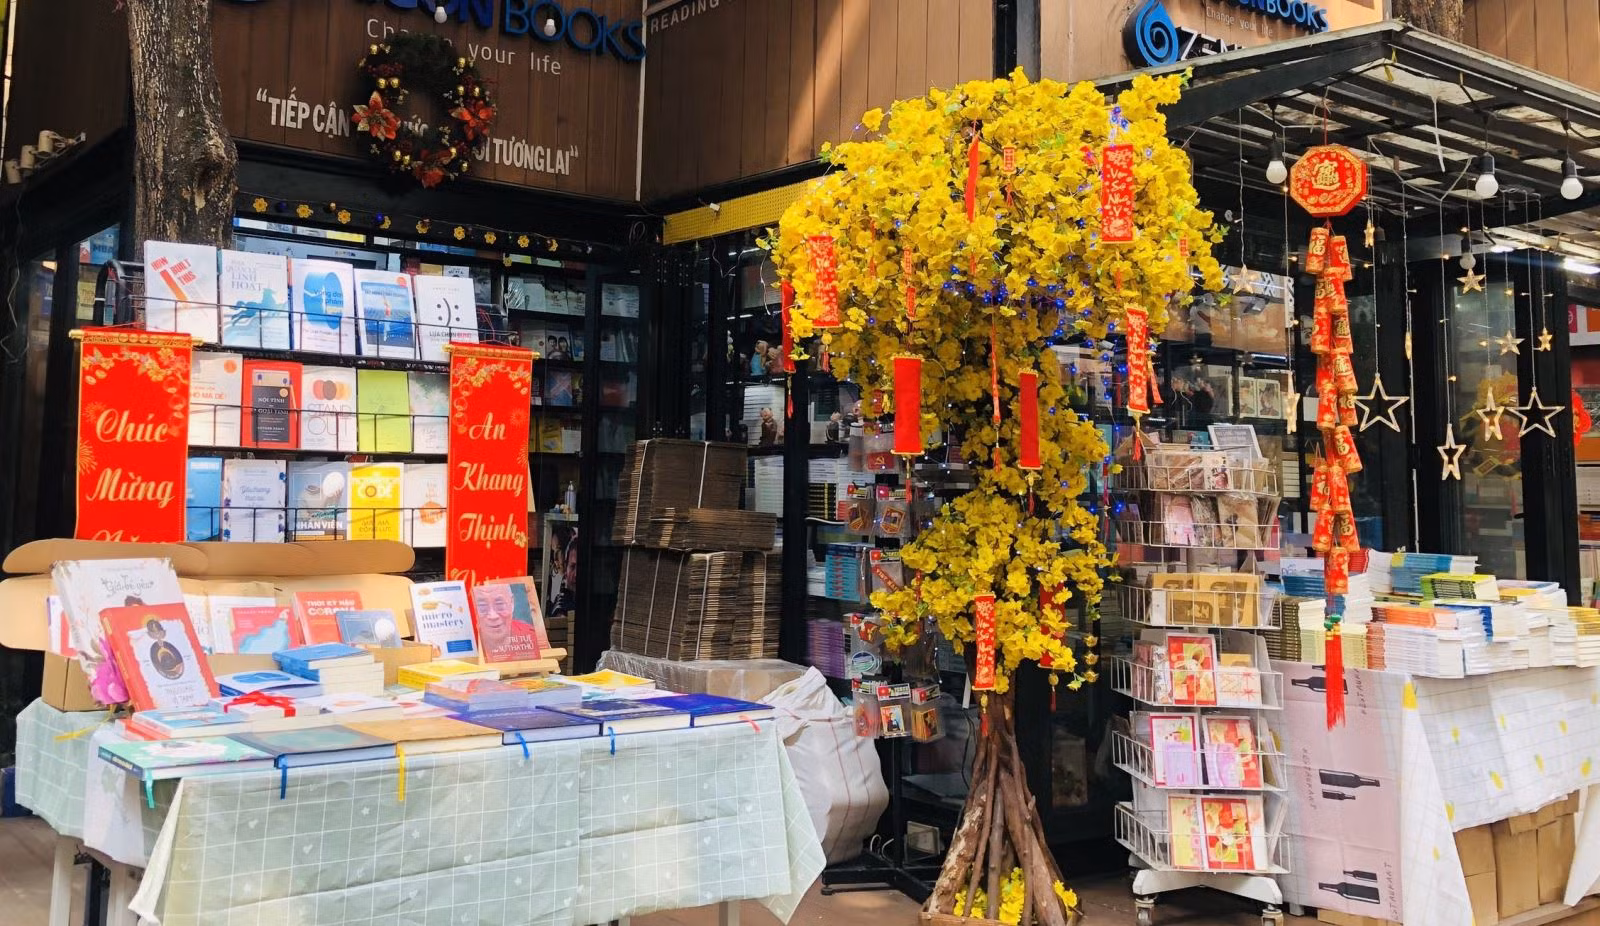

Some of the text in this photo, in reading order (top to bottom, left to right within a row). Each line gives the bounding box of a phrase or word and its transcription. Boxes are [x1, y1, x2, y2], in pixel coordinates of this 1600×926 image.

[651, 0, 718, 34] READING
[1206, 6, 1235, 25] Change
[1239, 18, 1258, 33] your
[469, 42, 562, 75] your life
[312, 101, 351, 139] CẬN
[493, 135, 543, 172] TƯƠNG
[177, 270, 197, 286] THIS
[96, 408, 170, 443] Chúc
[307, 403, 352, 418] STAND
[308, 417, 350, 437] OUT
[468, 412, 507, 441] An
[86, 467, 175, 509] Mừng
[454, 461, 525, 497] Khang
[458, 512, 519, 549] Thịnh
[421, 612, 453, 622] micro
[423, 618, 465, 629] mastery
